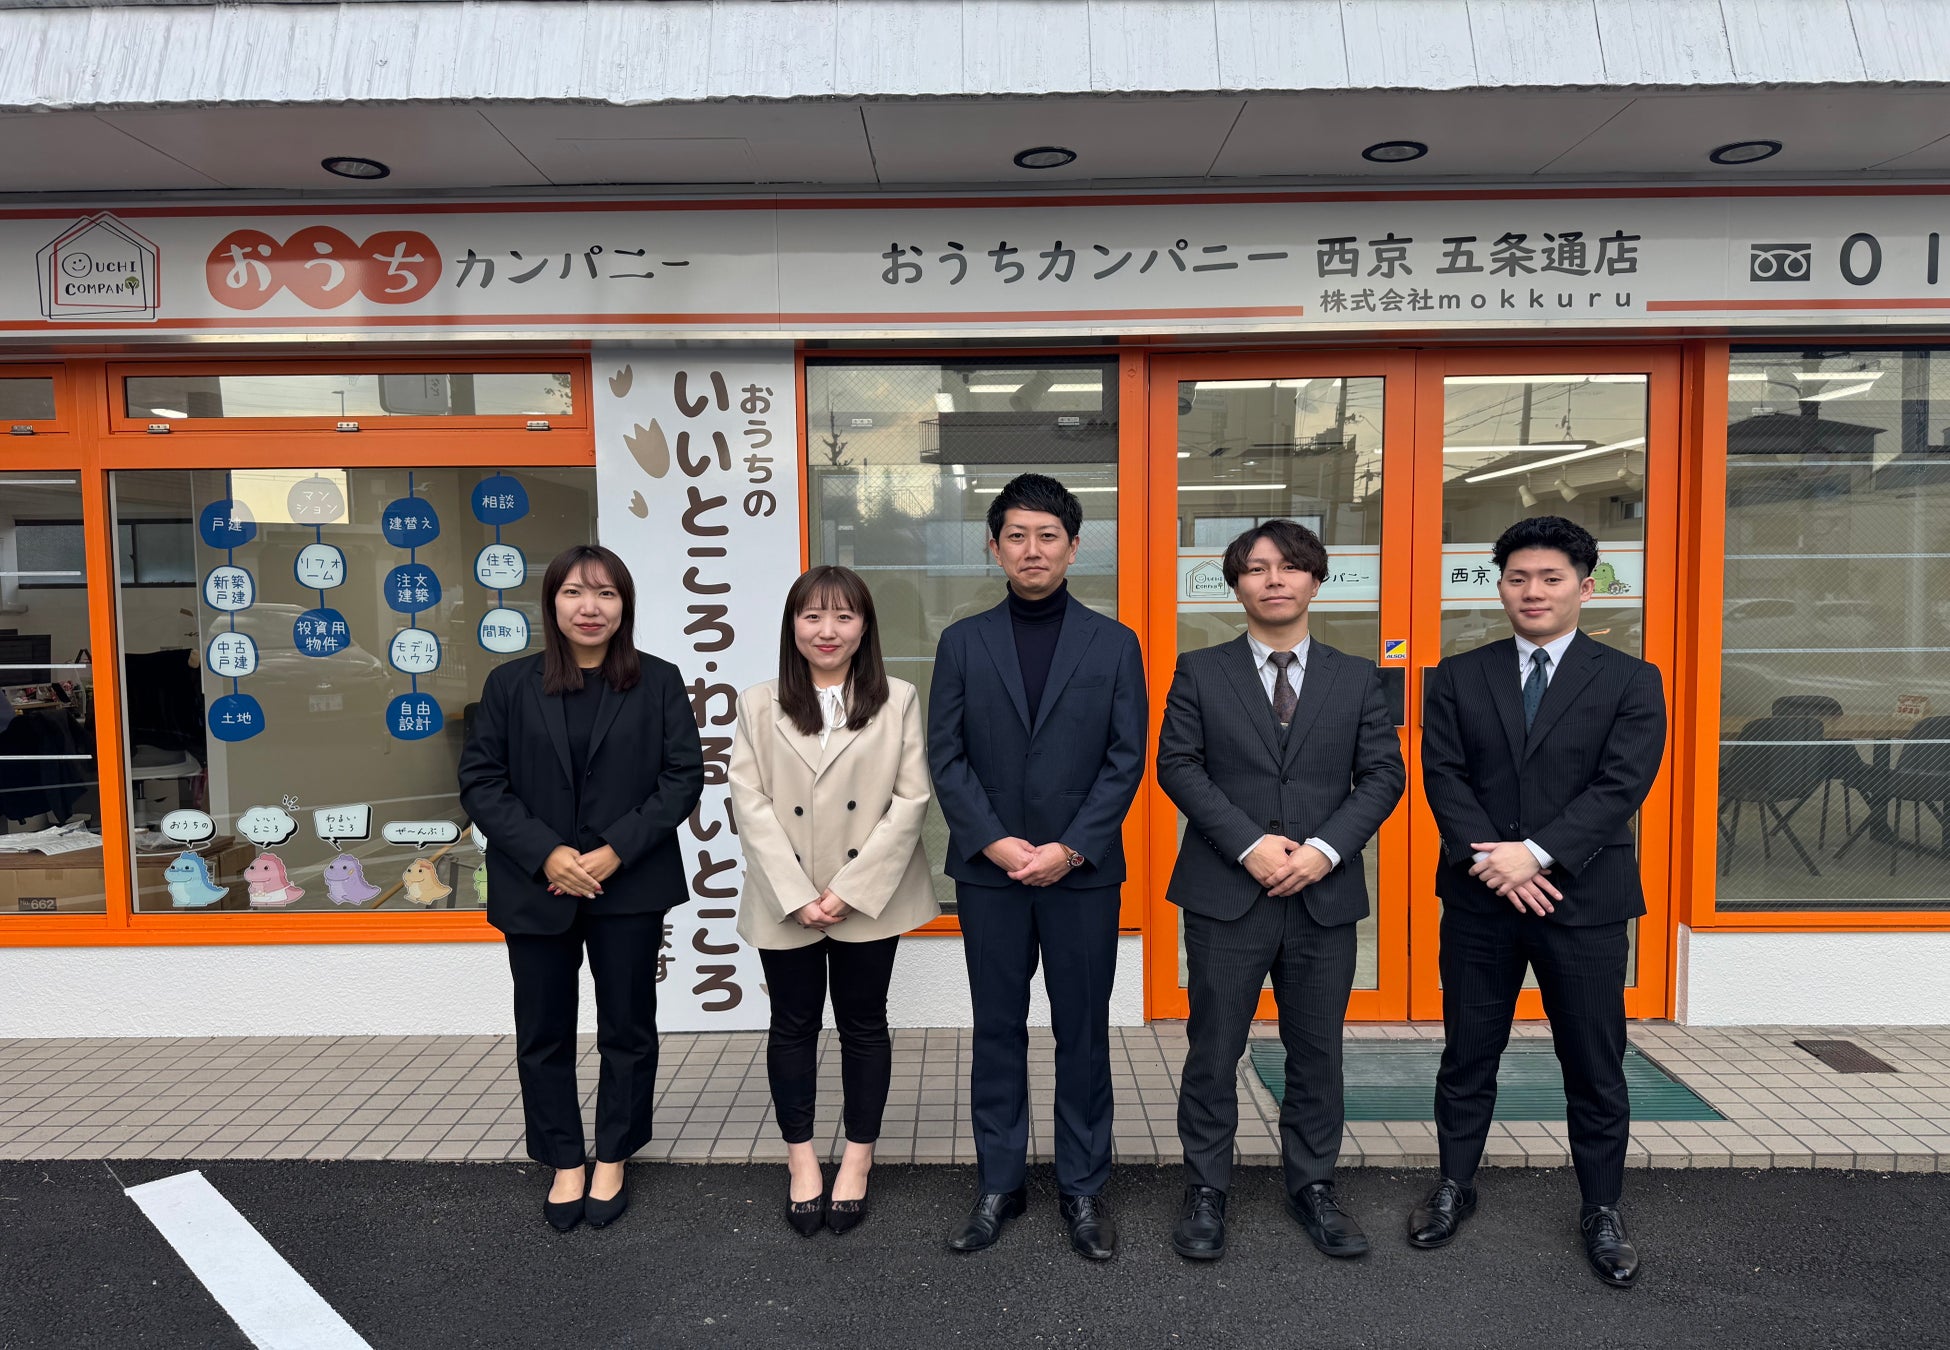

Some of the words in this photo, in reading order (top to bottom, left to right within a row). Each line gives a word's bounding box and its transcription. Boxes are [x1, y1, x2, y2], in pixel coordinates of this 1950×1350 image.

[882, 238, 1289, 285] おうちカンパニー
[1436, 230, 1641, 279] 五条通店
[65, 281, 138, 296] COMPANY
[740, 383, 777, 518] おうちの
[303, 490, 330, 502] マン
[482, 494, 515, 510] 相談
[296, 502, 338, 515] ション
[211, 516, 243, 533] 戸建
[388, 516, 433, 532] 建替え
[486, 552, 516, 567] 住宅
[397, 573, 428, 588] 注文
[480, 568, 523, 580] ローン
[212, 574, 246, 590] 新築
[215, 590, 246, 604] 戸建
[398, 588, 430, 603] 建築
[297, 621, 346, 636] 投資用
[482, 624, 525, 639] 間取り
[217, 640, 246, 655] 中古
[305, 636, 339, 651] 物件
[395, 641, 436, 653] モデル
[217, 655, 249, 670] 戸建
[395, 653, 435, 664] ハウス
[400, 701, 431, 715] 自由
[220, 711, 252, 725] 土地
[398, 716, 432, 731] 設計
[170, 821, 209, 830] おうちの
[325, 814, 357, 823] わるい
[253, 825, 279, 833] ところ
[328, 824, 355, 832] ところ
[31, 899, 55, 910] 662
